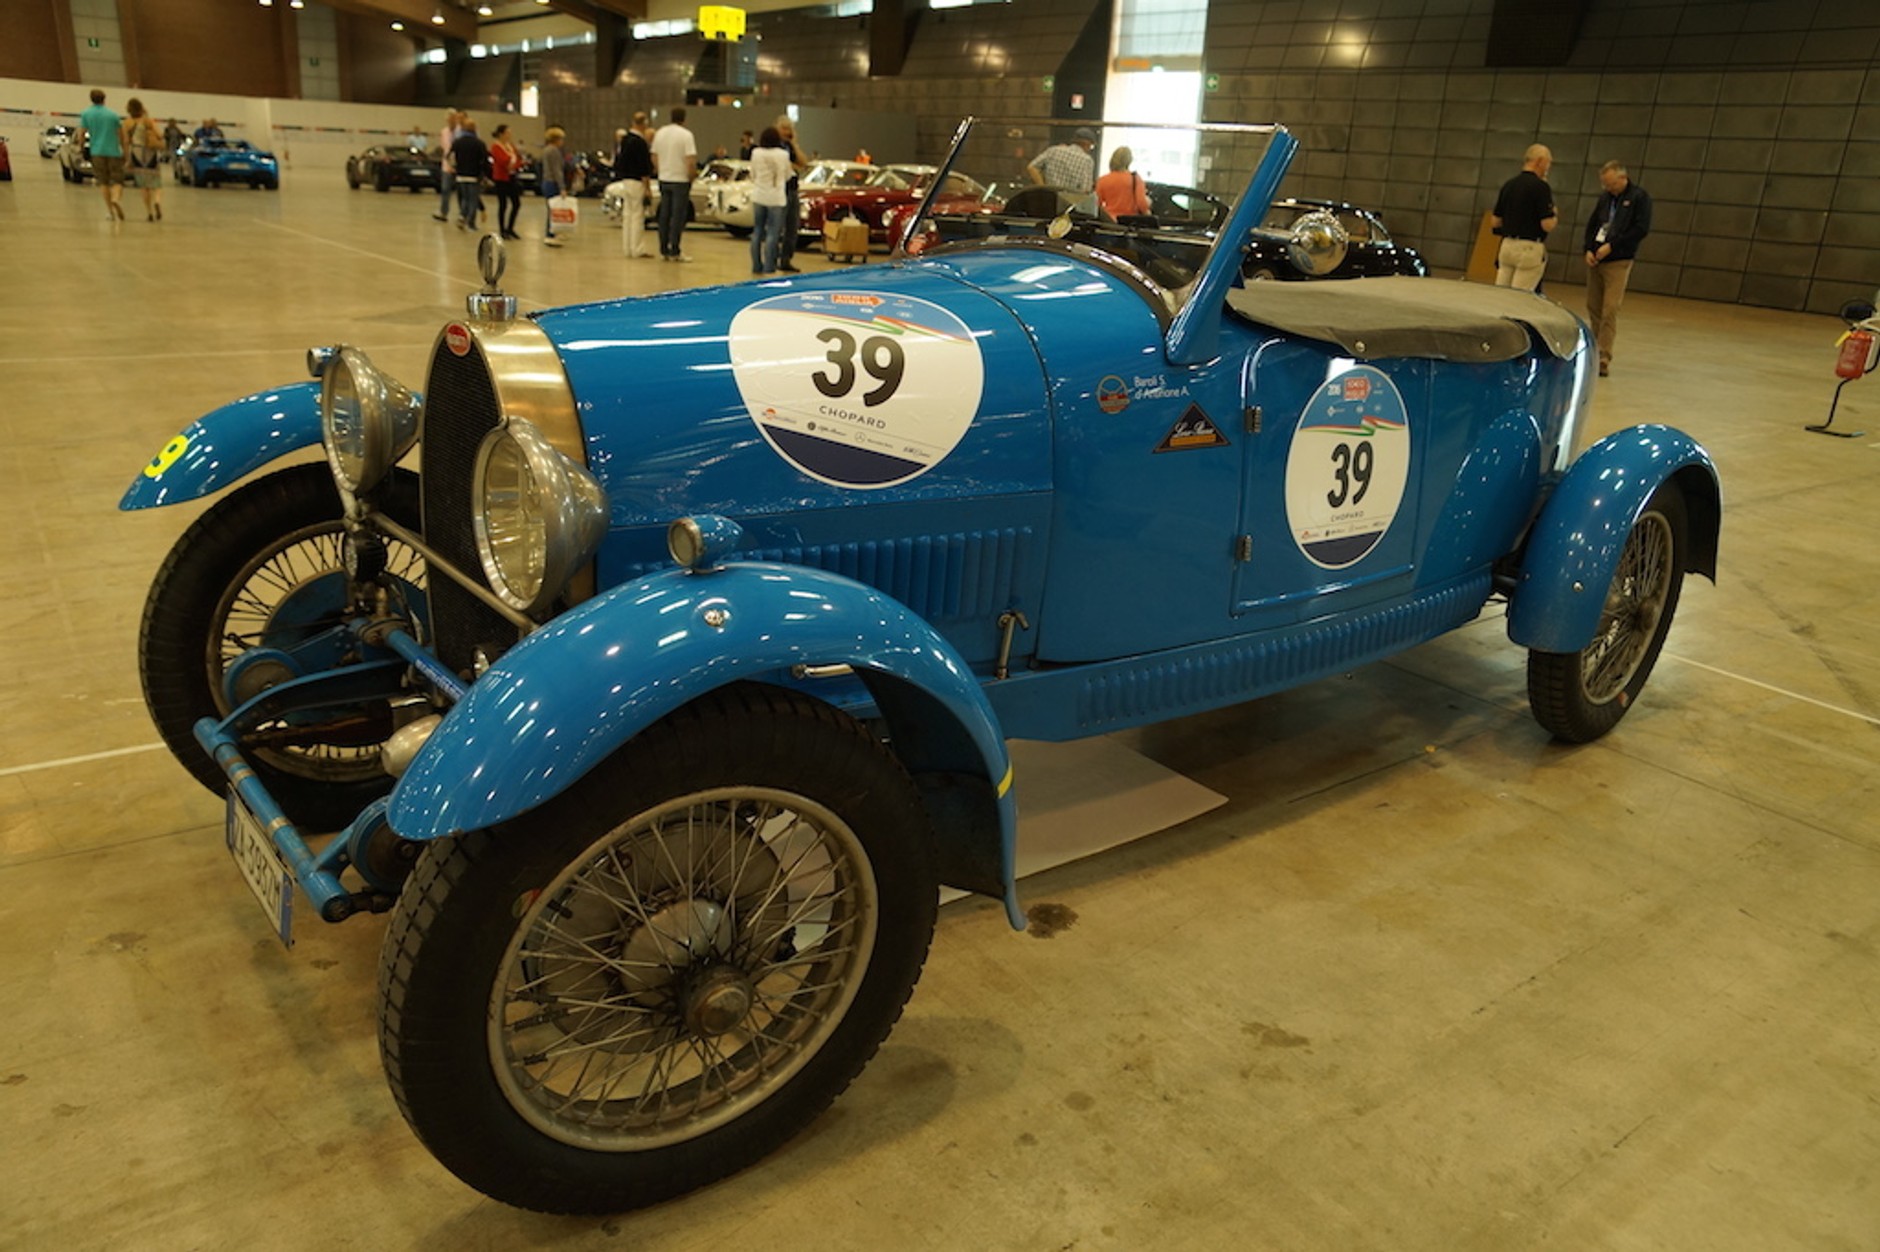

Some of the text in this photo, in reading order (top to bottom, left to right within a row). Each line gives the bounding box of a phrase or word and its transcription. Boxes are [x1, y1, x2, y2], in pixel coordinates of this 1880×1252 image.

[811, 328, 905, 408] 39
[819, 405, 887, 430] CHOPARD
[1327, 440, 1373, 508] 39
